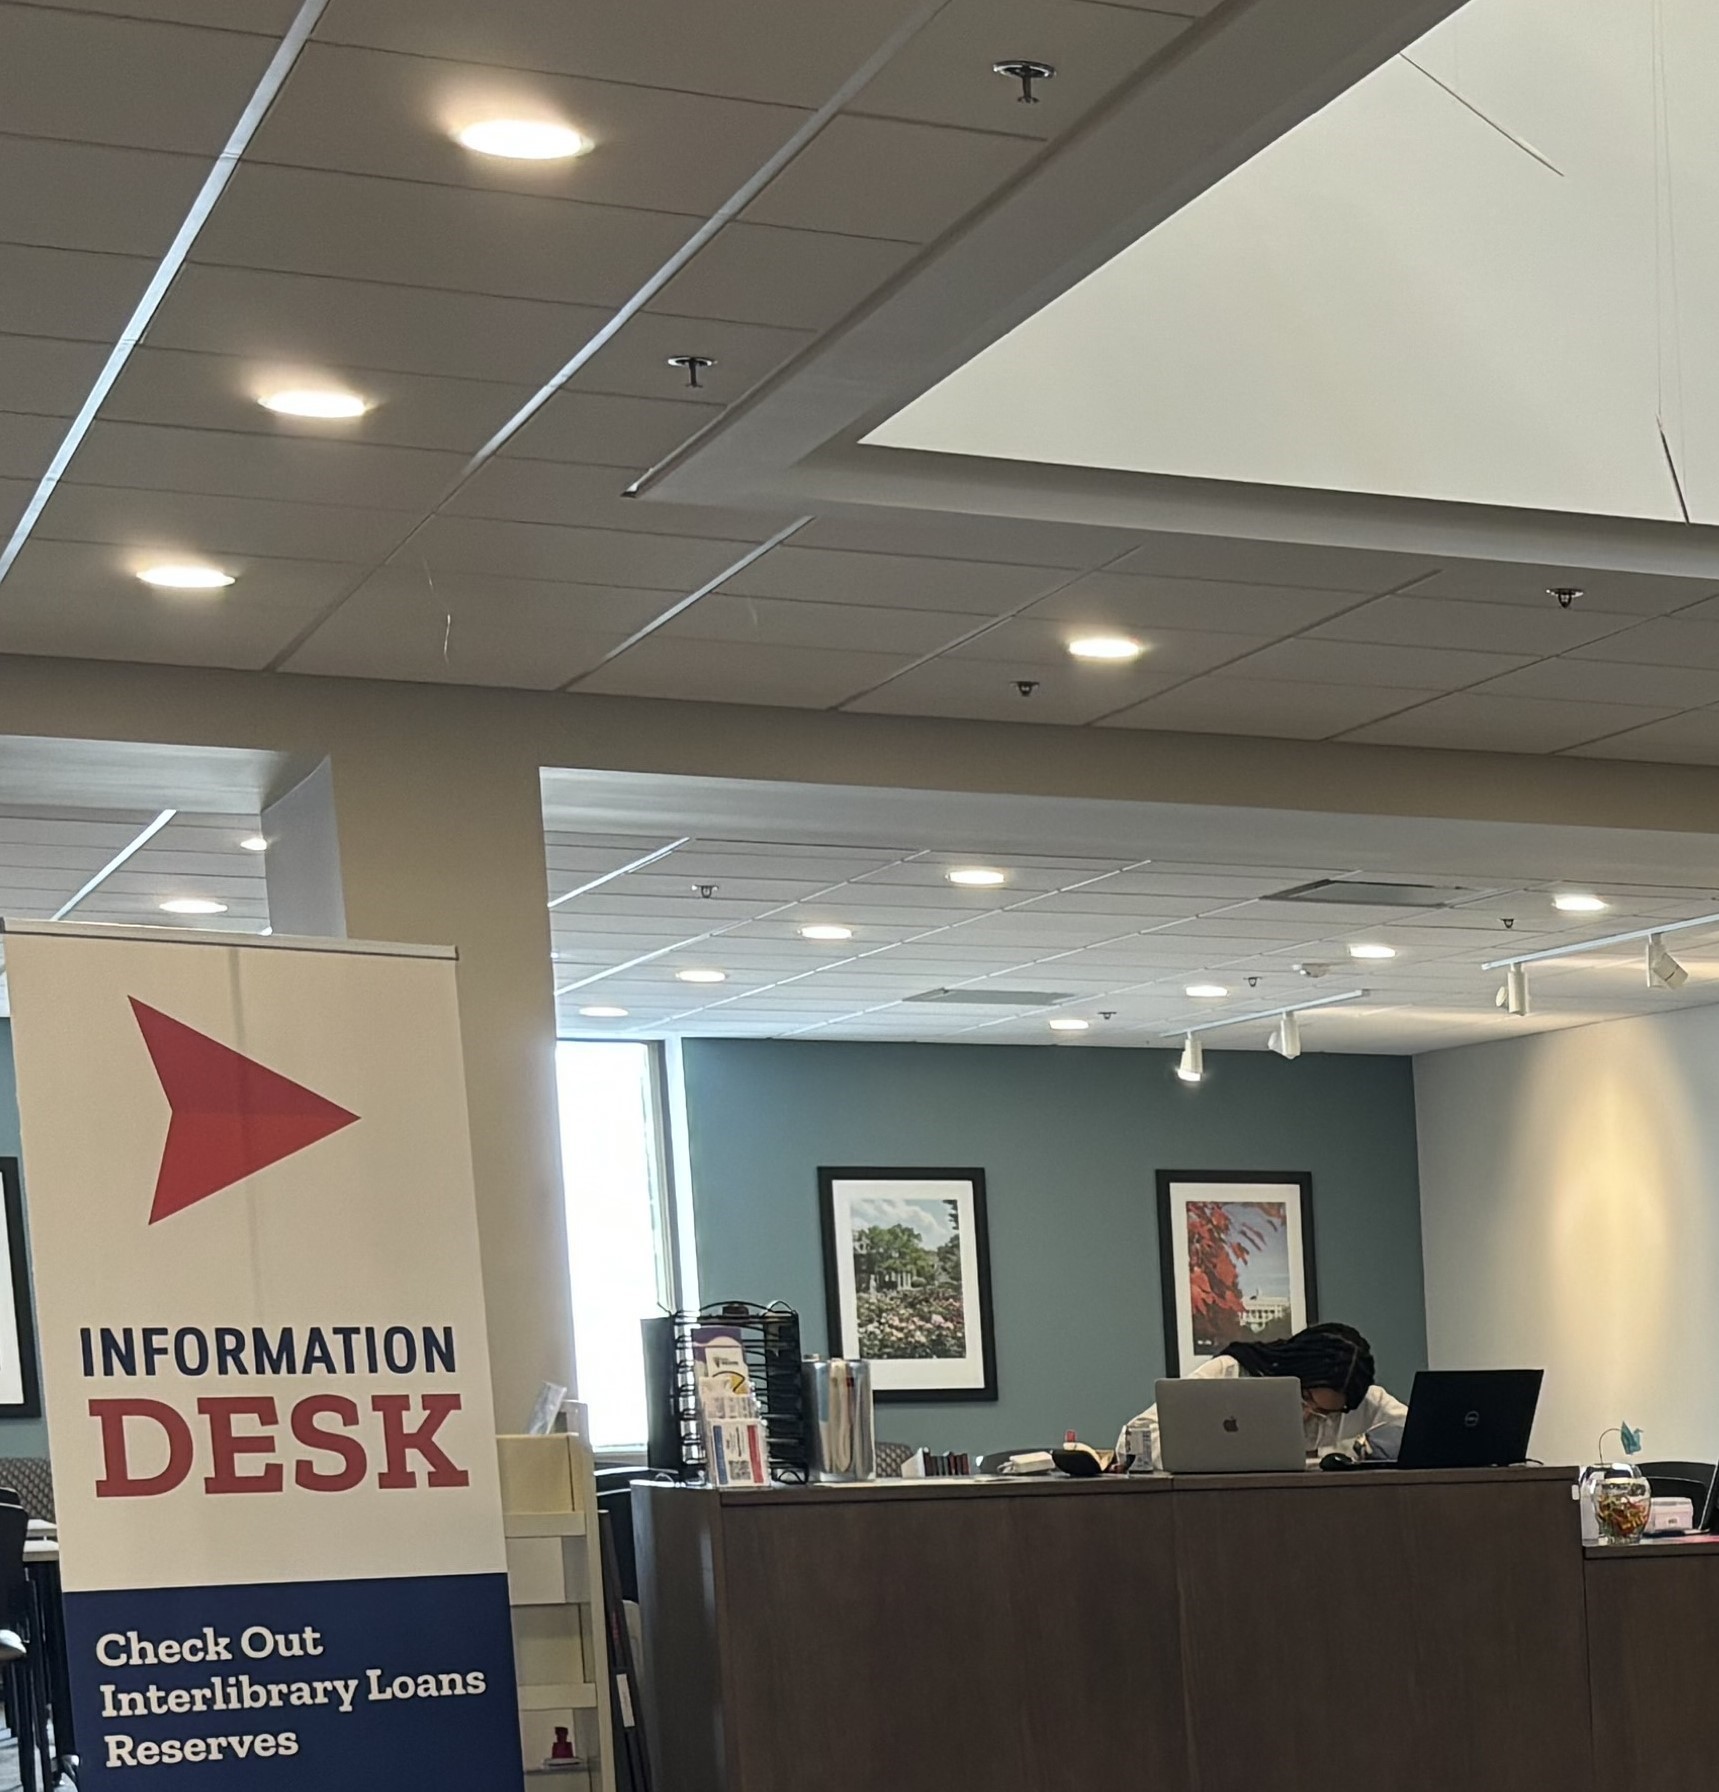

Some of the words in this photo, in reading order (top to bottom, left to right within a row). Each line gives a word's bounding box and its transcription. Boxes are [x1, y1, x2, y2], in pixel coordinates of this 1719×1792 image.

[79, 1325, 456, 1377] INFORMATION
[87, 1393, 470, 1498] DESK
[95, 1626, 233, 1667] Check
[240, 1625, 324, 1659] Out
[99, 1674, 359, 1718] Interlibrary
[365, 1668, 486, 1701] Loans
[103, 1731, 299, 1768] Reserves
